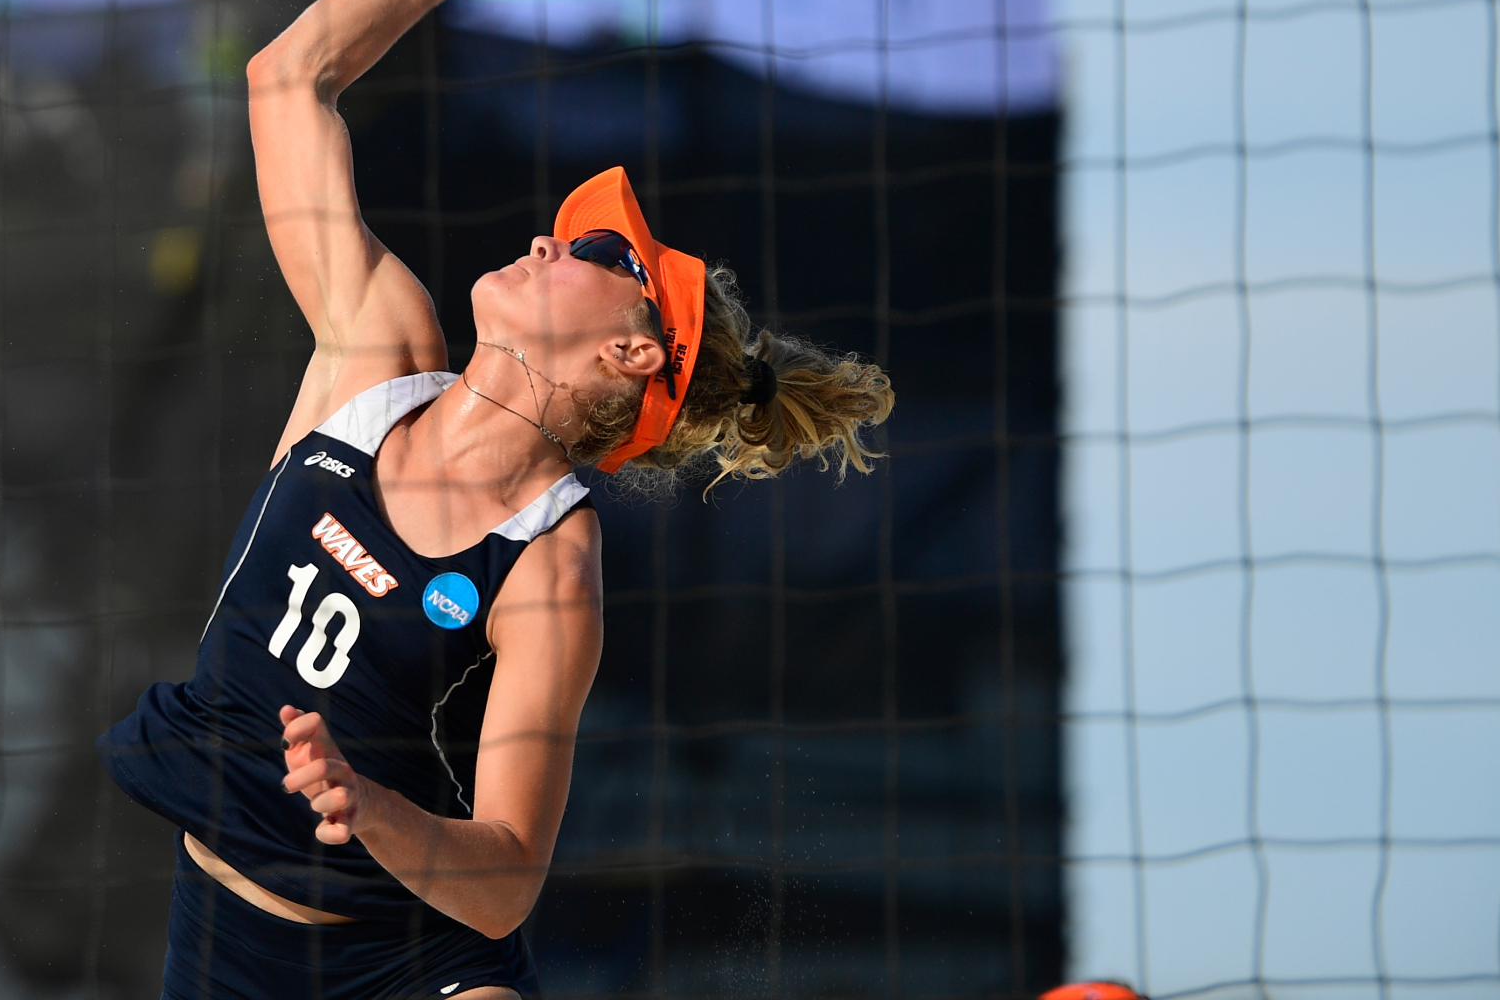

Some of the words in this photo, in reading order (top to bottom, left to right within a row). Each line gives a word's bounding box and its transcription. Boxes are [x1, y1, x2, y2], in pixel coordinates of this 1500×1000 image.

[672, 343, 688, 375] BEACH
[319, 455, 356, 479] asics
[312, 512, 399, 597] WAVES
[268, 562, 361, 690] 10
[426, 588, 471, 626] NCAA
